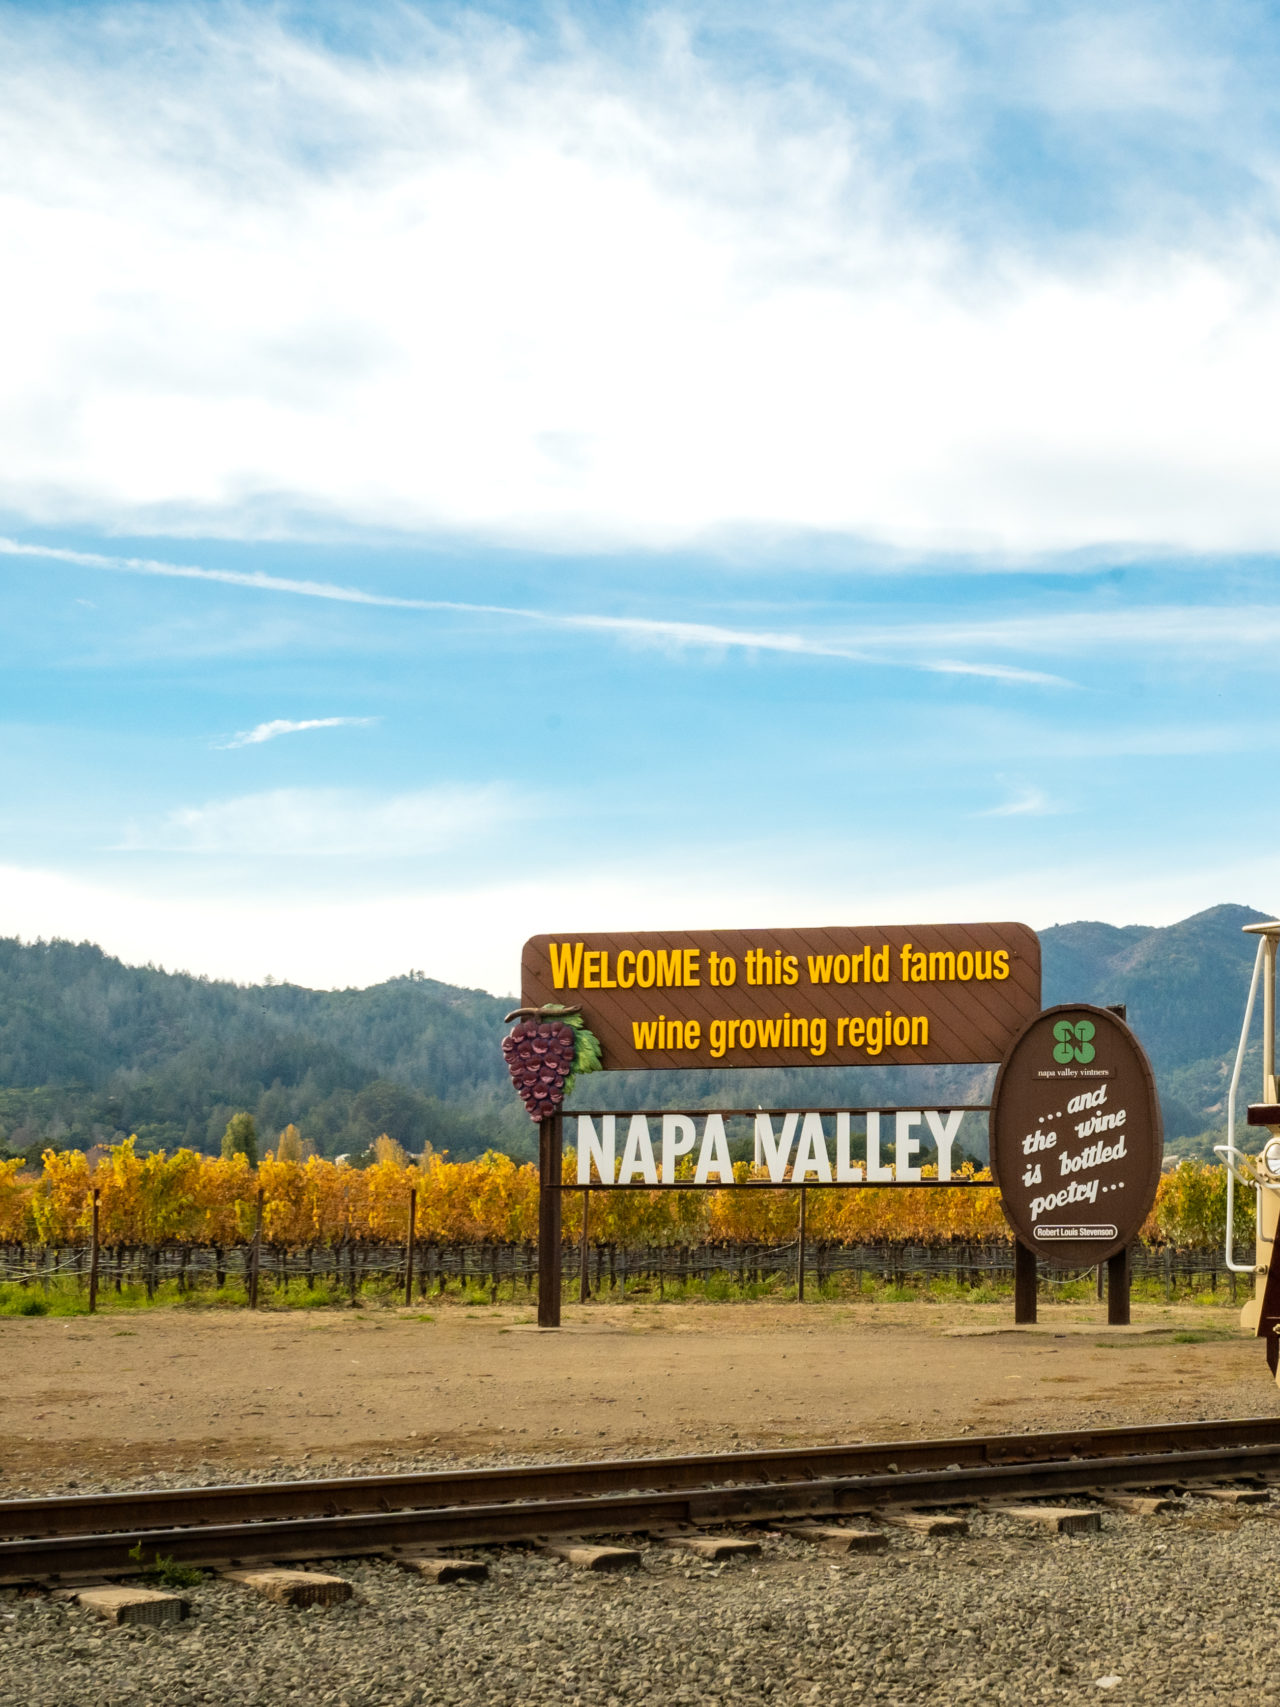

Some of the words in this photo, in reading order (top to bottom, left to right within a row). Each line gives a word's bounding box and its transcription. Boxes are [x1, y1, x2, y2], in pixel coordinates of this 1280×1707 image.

[549, 942, 701, 989] WELCOME
[708, 951, 737, 987] to
[745, 948, 800, 985] this
[807, 944, 890, 984] world
[900, 943, 1010, 982] famous
[632, 1014, 701, 1050] wine
[709, 1012, 827, 1058] growing
[837, 1011, 929, 1055] region
[1038, 1070, 1057, 1079] napa
[1057, 1068, 1079, 1078] valley
[1080, 1067, 1110, 1076] vintners
[577, 1113, 735, 1185] NAPA
[755, 1110, 965, 1183] VALLEY
[1022, 1130, 1057, 1155] the
[1074, 1109, 1127, 1139] wine
[1022, 1164, 1043, 1187] is
[1058, 1135, 1128, 1176] bottled
[1037, 1228, 1060, 1237] Robert
[1060, 1227, 1078, 1236] Louis
[1079, 1227, 1114, 1236] Stevenson
